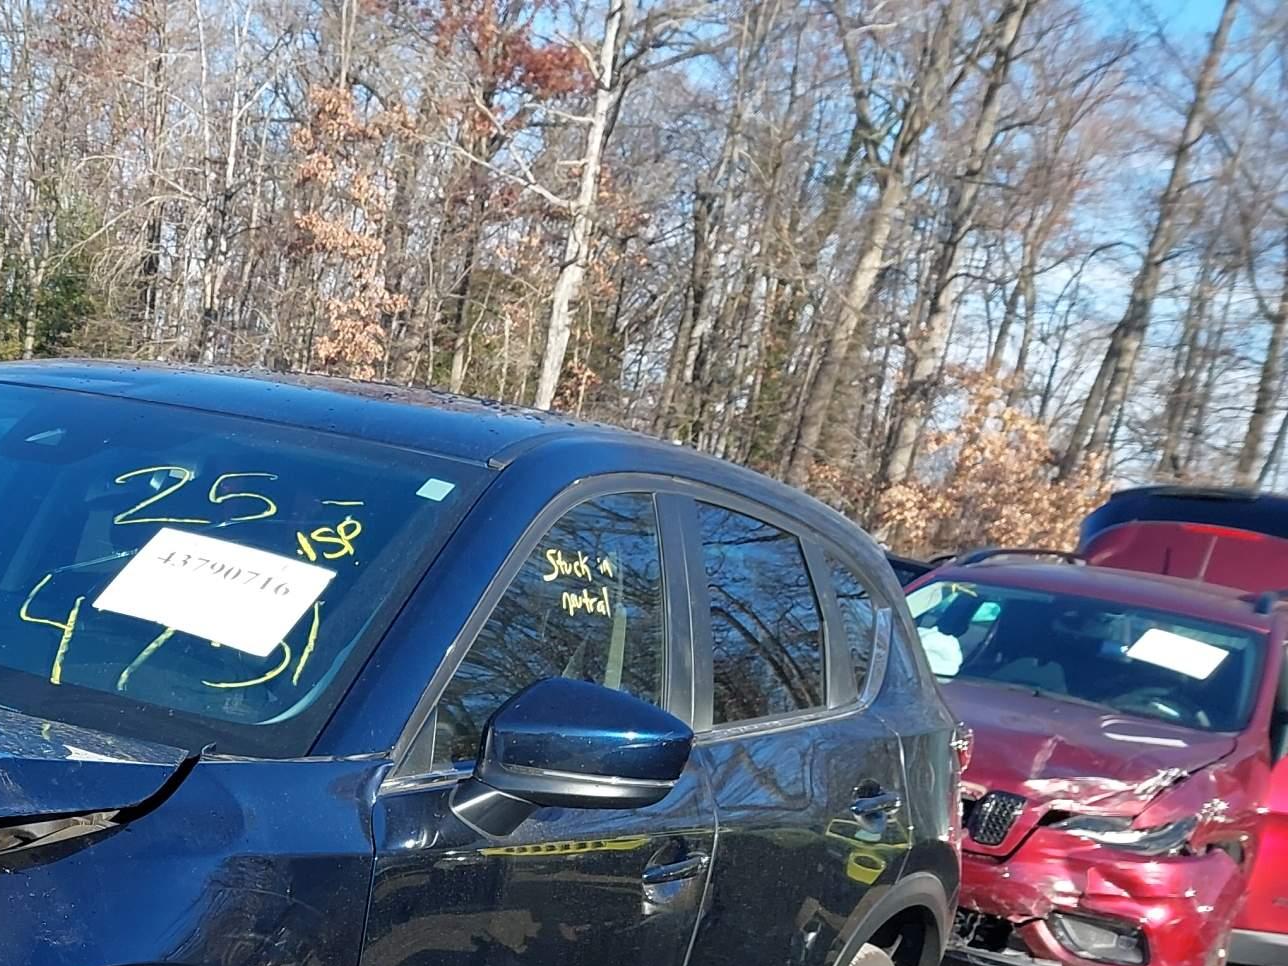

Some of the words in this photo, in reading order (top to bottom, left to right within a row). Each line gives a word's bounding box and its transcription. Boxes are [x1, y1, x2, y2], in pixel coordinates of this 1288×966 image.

[113, 465, 279, 525] 25
[157, 550, 291, 597] 43790716
[543, 549, 592, 582] Stuck
[596, 556, 613, 578] in
